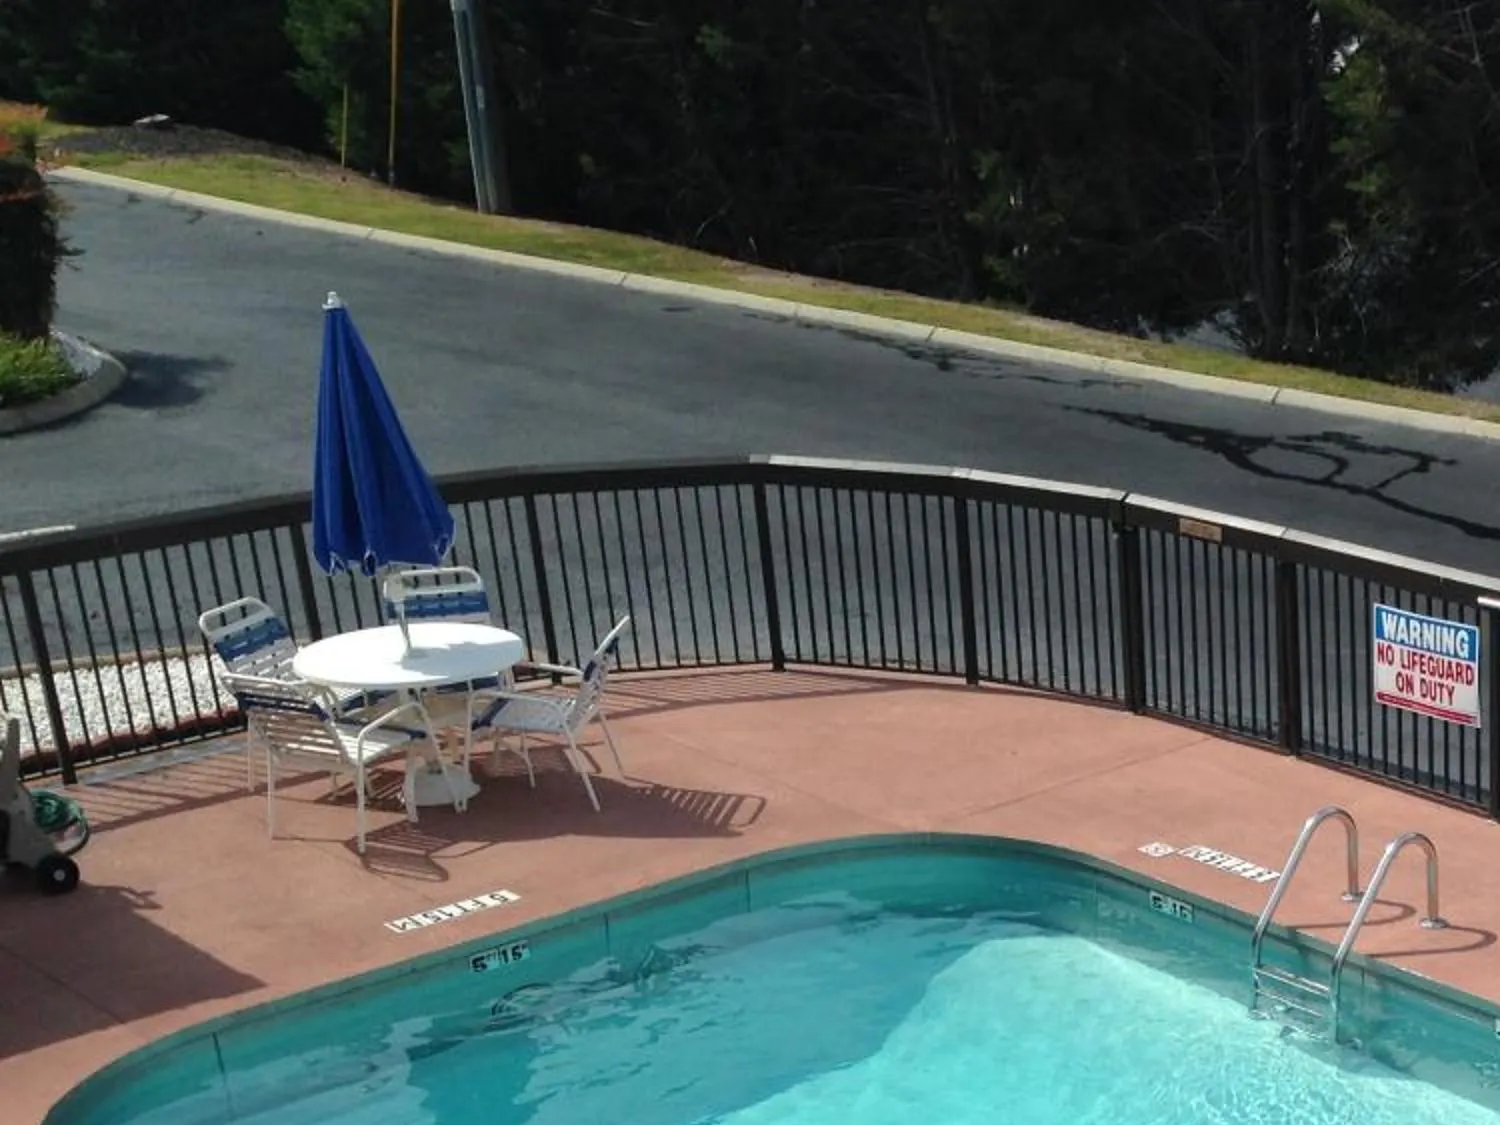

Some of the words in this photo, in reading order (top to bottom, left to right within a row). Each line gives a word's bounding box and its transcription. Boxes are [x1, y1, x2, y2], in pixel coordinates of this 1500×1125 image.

[1382, 611, 1469, 658] WARNING
[1377, 642, 1395, 667] NO
[1400, 647, 1475, 686] LIFEGUARD
[1395, 671, 1414, 697] ON
[1420, 678, 1455, 705] DUTY
[471, 956, 488, 973] 5
